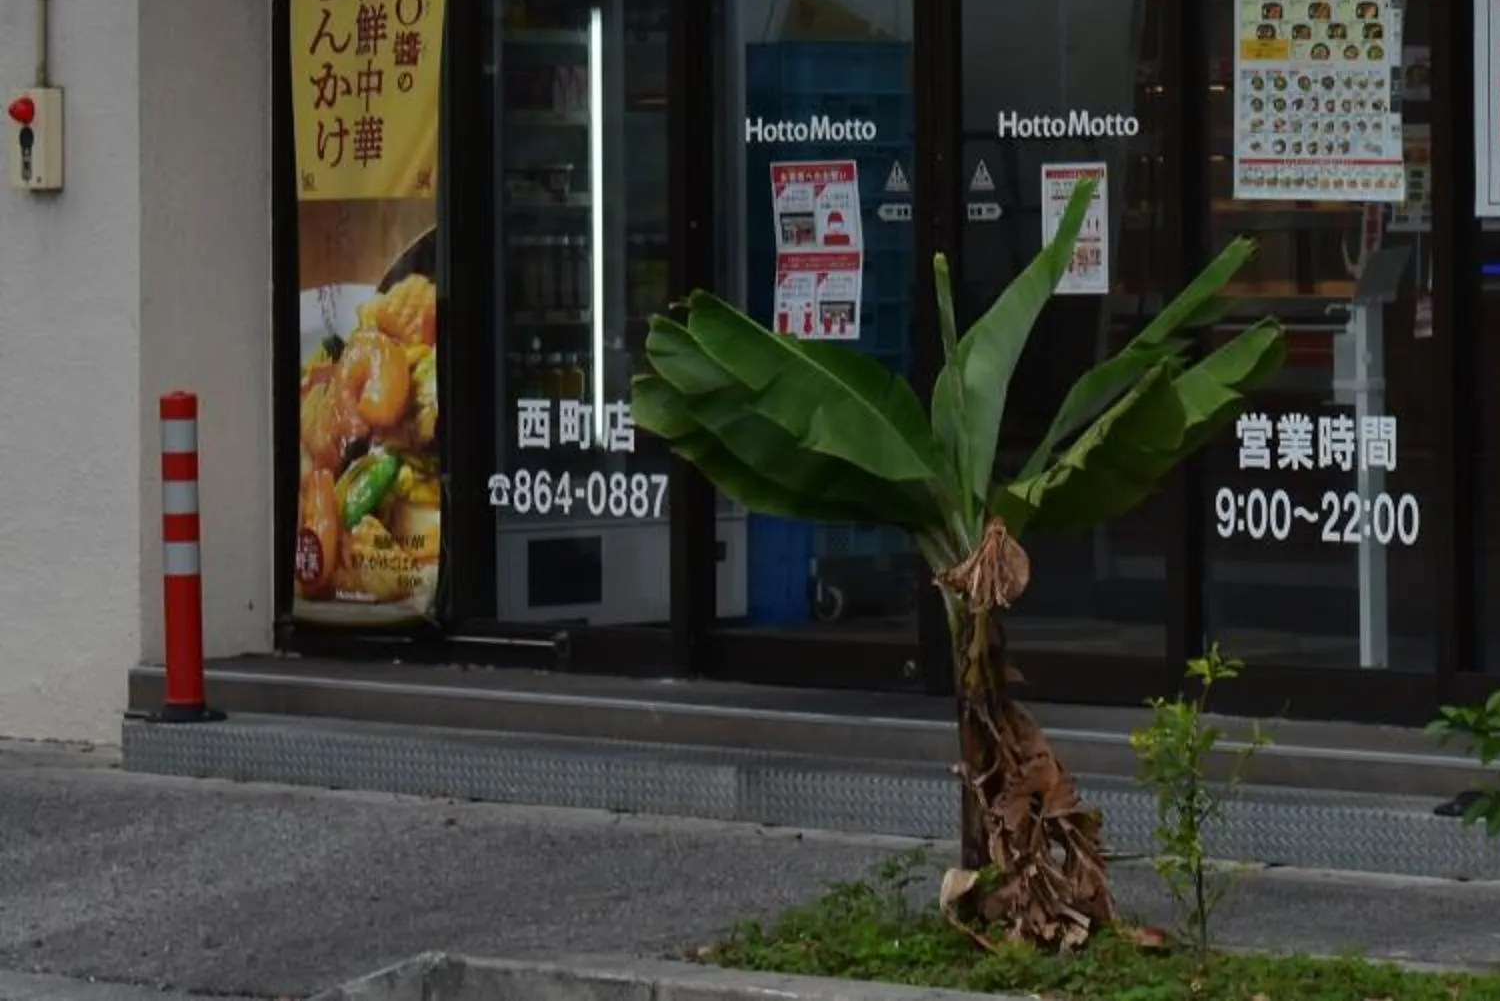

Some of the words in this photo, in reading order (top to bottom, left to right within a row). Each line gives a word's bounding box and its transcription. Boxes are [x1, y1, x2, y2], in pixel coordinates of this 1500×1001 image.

[517, 398, 636, 453] 西町店
[1236, 411, 1398, 472] 営業時間
[513, 468, 669, 519] 864-0887
